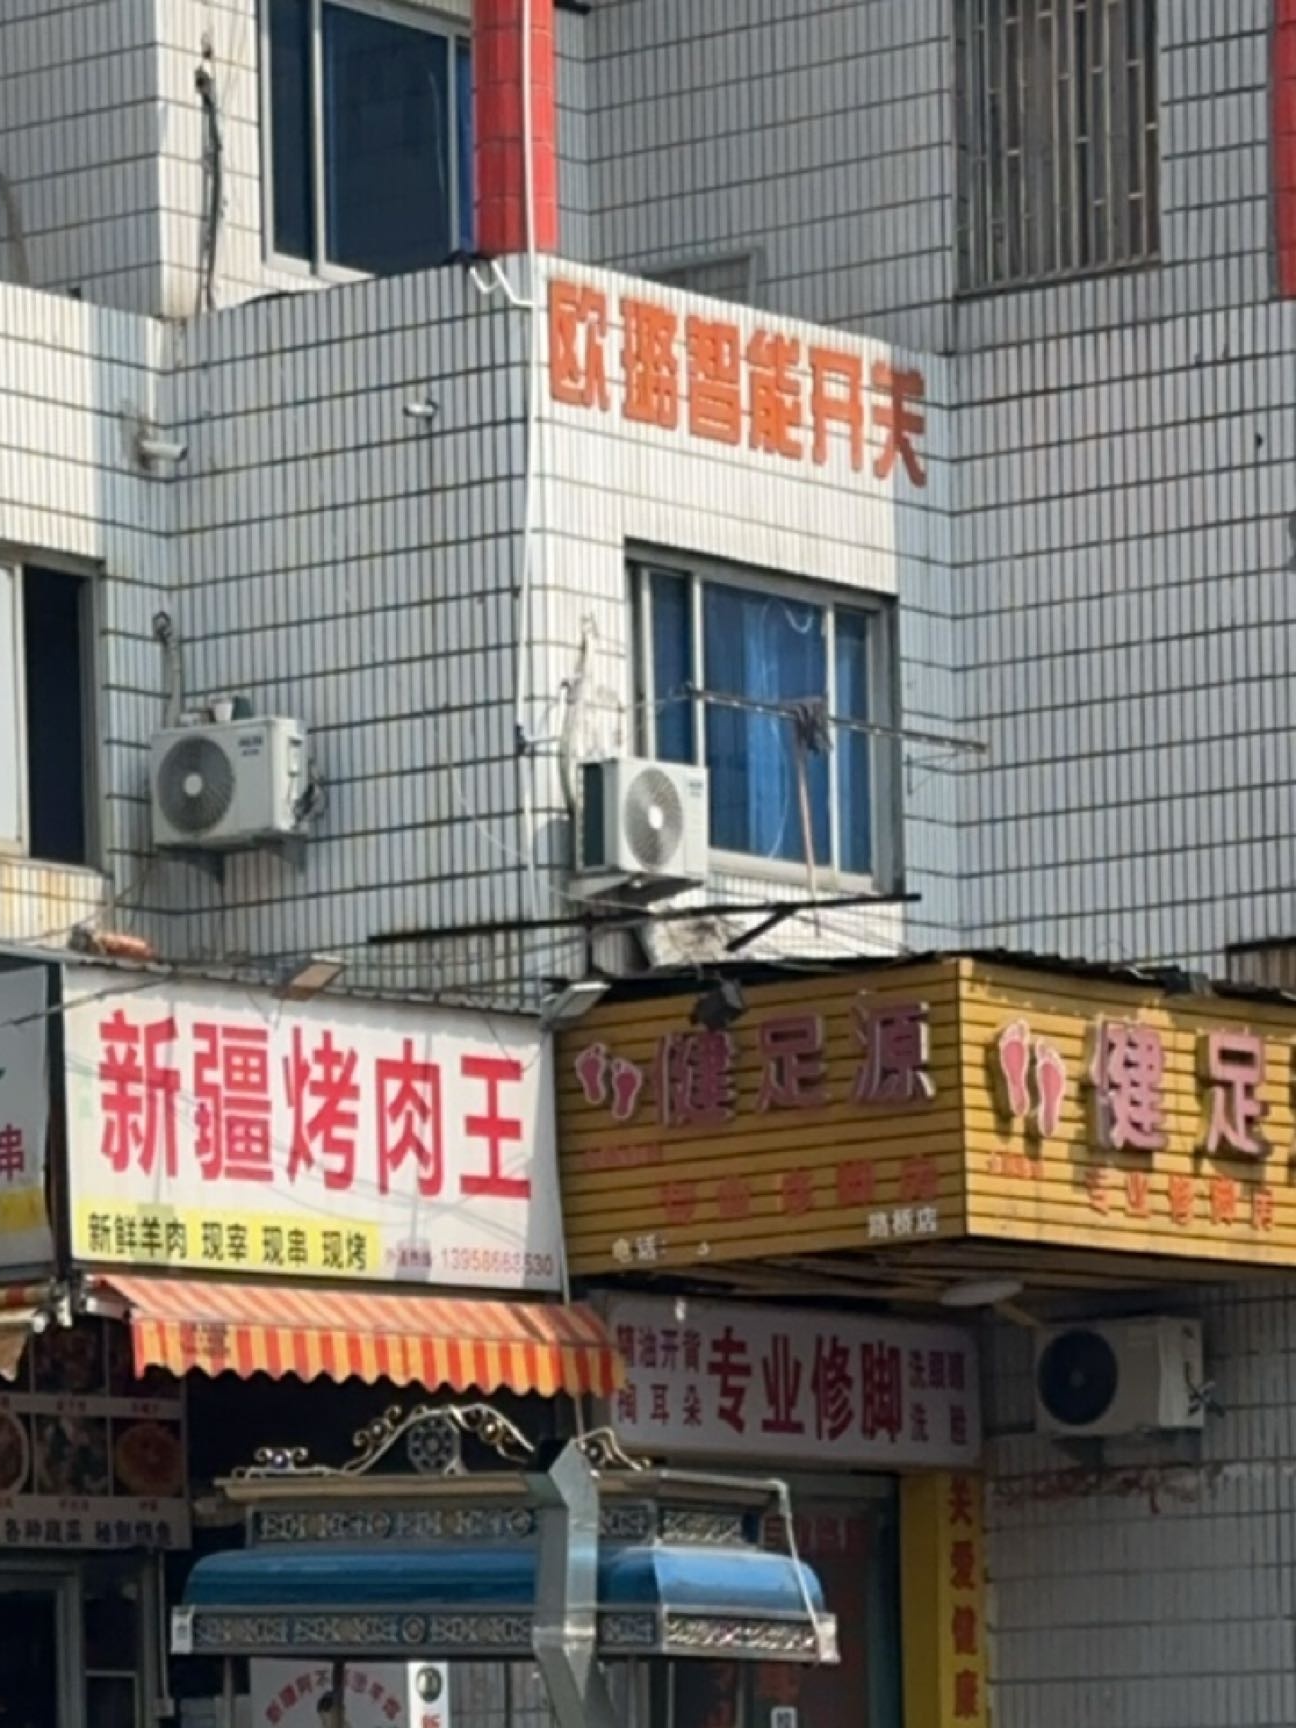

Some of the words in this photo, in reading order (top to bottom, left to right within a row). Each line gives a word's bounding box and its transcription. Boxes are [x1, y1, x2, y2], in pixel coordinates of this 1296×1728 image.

[98, 1008, 532, 1199] 新疆烤肉王
[655, 1001, 936, 1127] 健足源
[87, 1213, 188, 1260] 新鲜羊肉
[201, 1219, 248, 1262] 现宰
[261, 1224, 308, 1264] 现串
[321, 1229, 368, 1271] 现烤
[708, 1325, 903, 1443] 专业修脚
